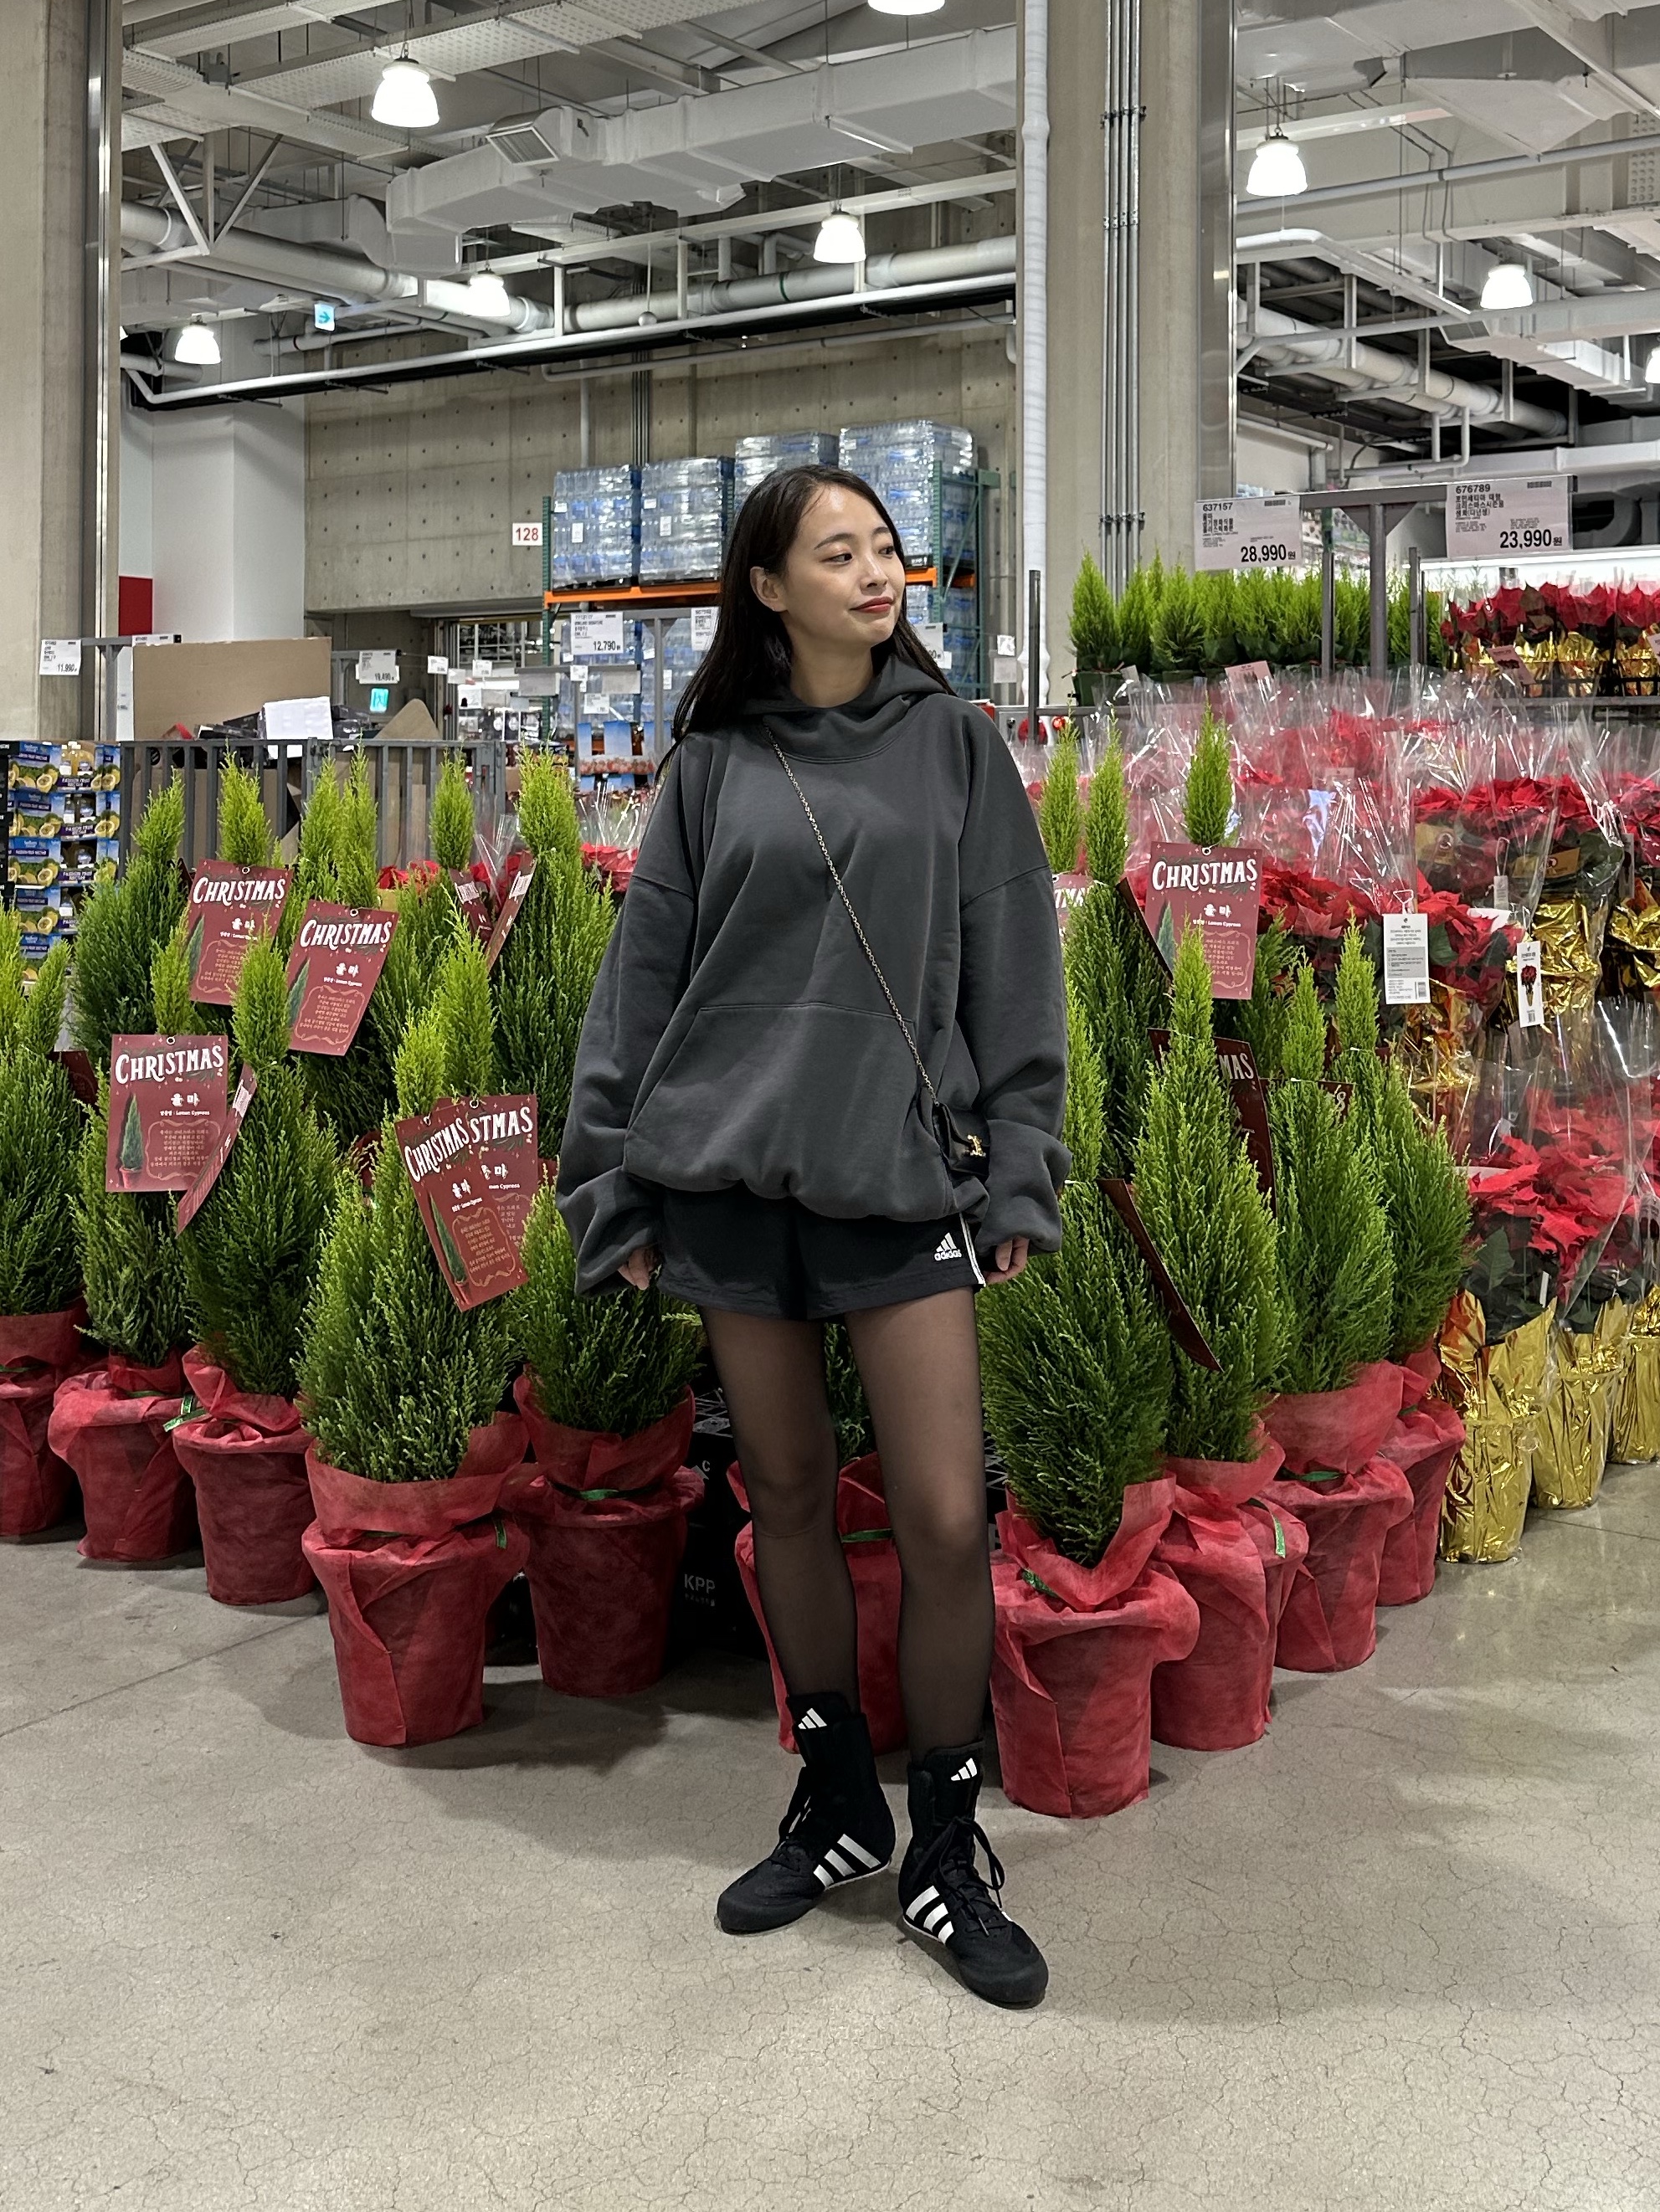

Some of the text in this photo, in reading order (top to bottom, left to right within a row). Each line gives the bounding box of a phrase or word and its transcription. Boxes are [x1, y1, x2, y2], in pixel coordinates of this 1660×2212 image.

[1456, 484, 1490, 494] 676789
[1203, 502, 1233, 511] 637157
[516, 527, 539, 541] 128
[1153, 859, 1257, 891] CHRISTMAS
[193, 877, 286, 906] CHRISTMAS
[301, 920, 393, 950] CHRISTMAS
[116, 1045, 224, 1084] CHRISTMAS
[470, 1106, 533, 1143] STMAS
[405, 1118, 469, 1182] CHRISTMAS
[934, 1250, 962, 1261] adidas
[684, 1573, 716, 1594] KPP
